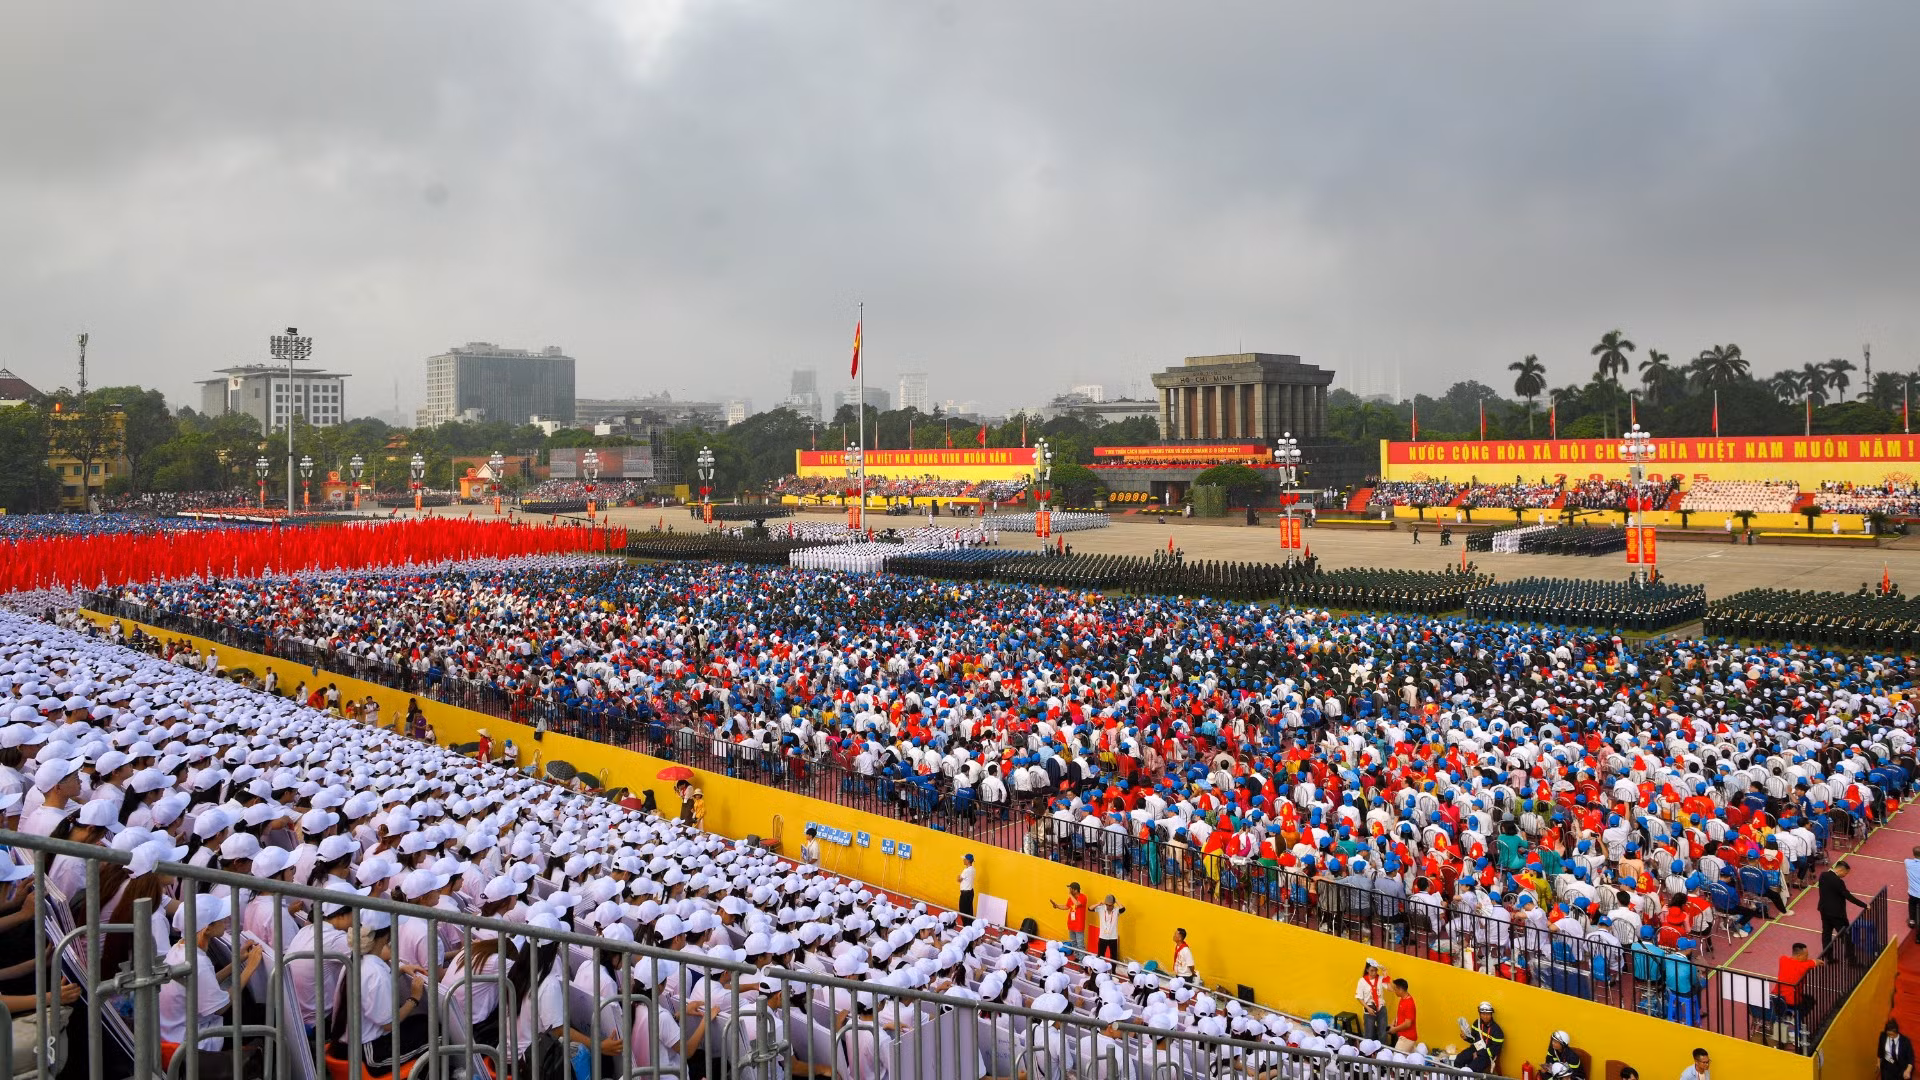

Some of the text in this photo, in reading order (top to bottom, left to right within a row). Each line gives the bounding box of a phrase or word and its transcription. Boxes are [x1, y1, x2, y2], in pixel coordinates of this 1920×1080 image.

[877, 452, 892, 465] VIỆT
[895, 453, 911, 464] NAM
[913, 453, 938, 465] QUANG
[941, 452, 960, 464] VINH
[963, 451, 986, 464] MUÔN
[1409, 444, 1445, 461] NƯỚC
[1452, 443, 1489, 463] CỘNG
[1497, 443, 1526, 460] HÒA
[1533, 443, 1552, 460] XÃ
[1559, 442, 1586, 462] HỘI
[1696, 440, 1736, 461] VIỆT
[1745, 441, 1783, 459] NAM
[1794, 438, 1848, 458] MUÔN
